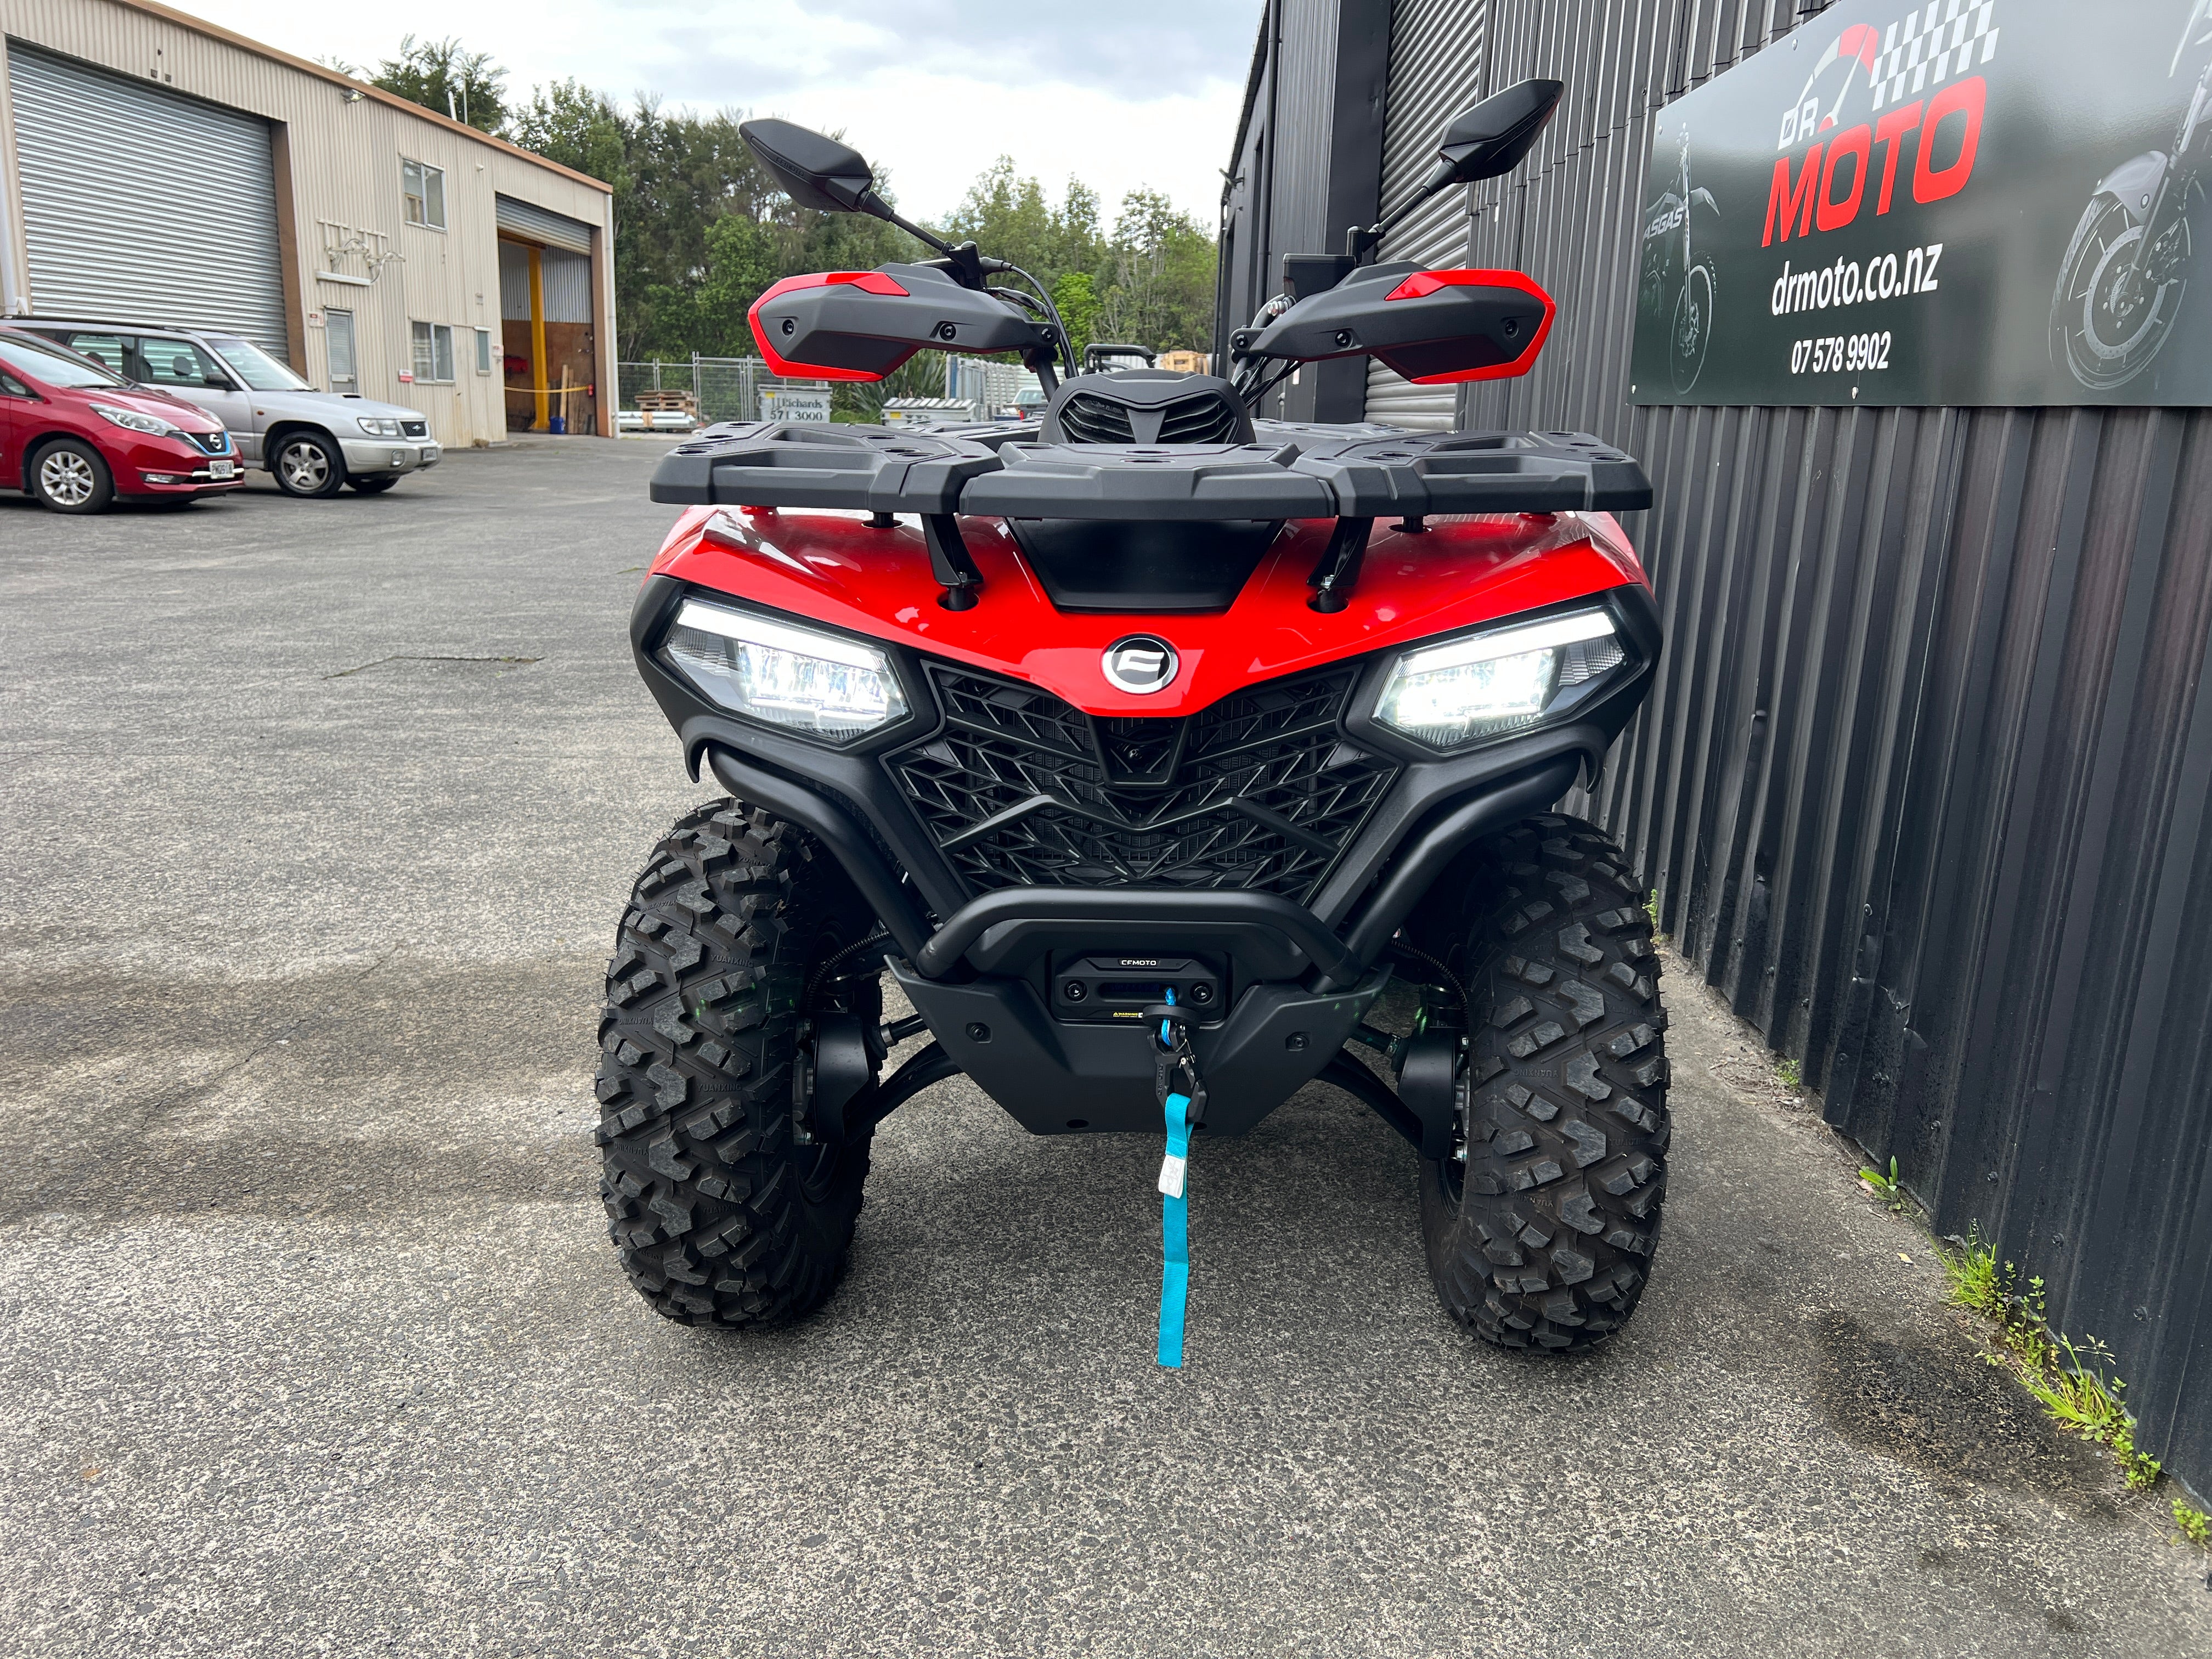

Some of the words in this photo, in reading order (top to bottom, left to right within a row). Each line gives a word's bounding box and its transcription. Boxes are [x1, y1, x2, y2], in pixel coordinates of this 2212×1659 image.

[1778, 97, 1819, 151] DR
[1762, 76, 1986, 247] MOTO
[1771, 242, 1943, 316] drmoto.co.nz
[1791, 339, 1813, 374] 07
[1813, 336, 1844, 373] 578
[1846, 331, 1891, 371] 9902
[770, 410, 789, 420] 571
[795, 411, 822, 420] 3000
[710, 953, 755, 968] YUANXING
[1514, 1068, 1559, 1078] YUANXING
[697, 1084, 742, 1092] YUANXING
